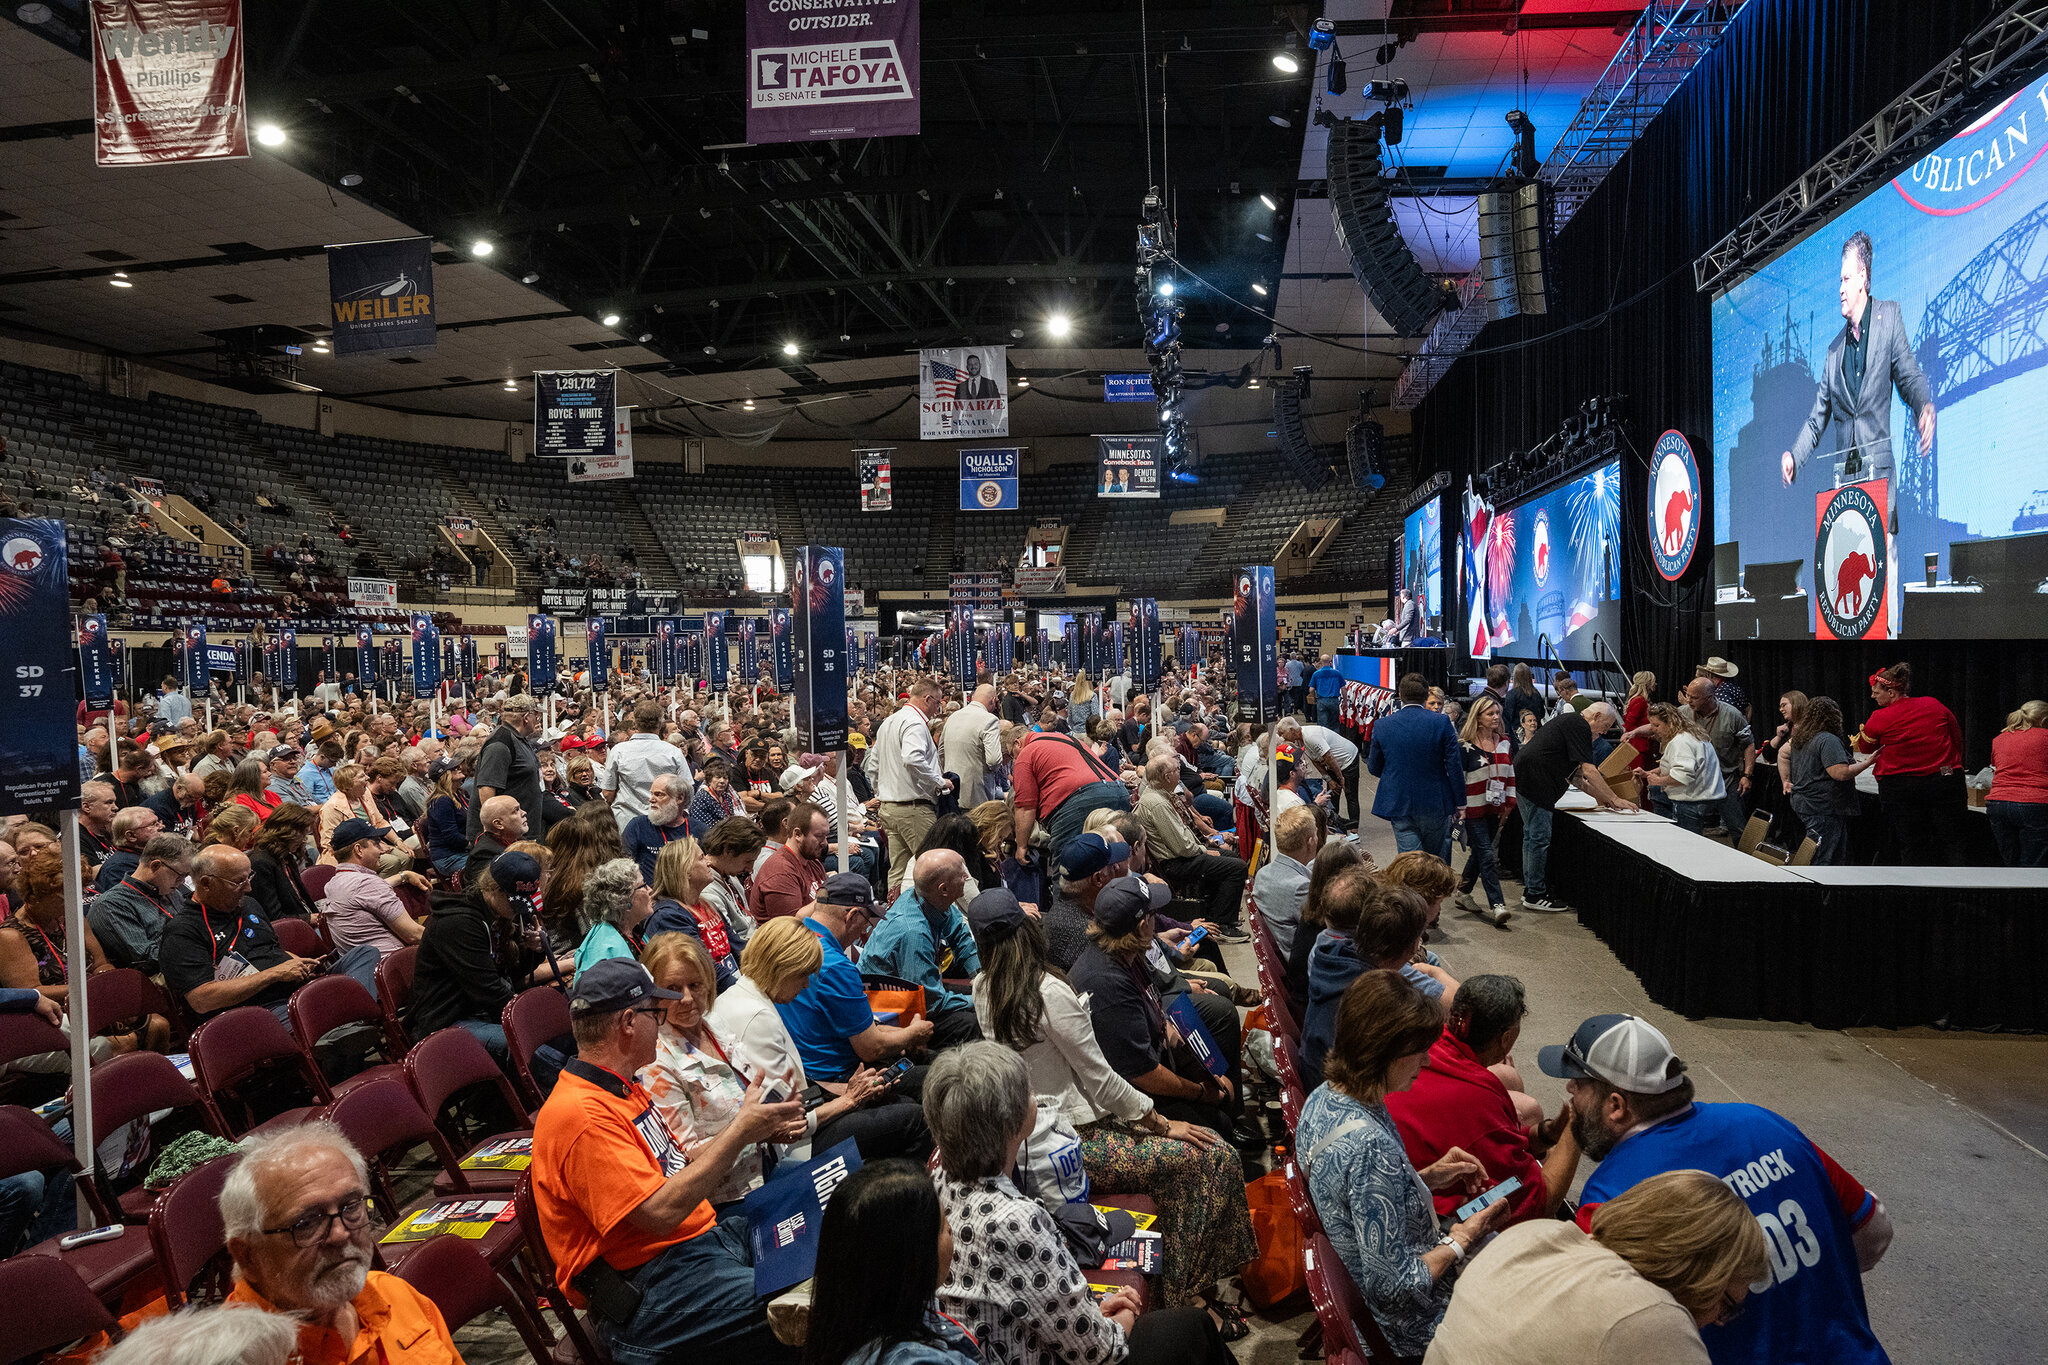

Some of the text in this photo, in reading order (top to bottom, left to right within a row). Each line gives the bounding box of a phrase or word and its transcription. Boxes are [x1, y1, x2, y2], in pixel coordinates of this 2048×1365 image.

[789, 12, 873, 31] OUTSIDER.
[101, 20, 235, 60] Wendy
[791, 48, 857, 65] MICHELE
[137, 69, 200, 88] Phillips
[790, 62, 900, 88] TAFOYA
[758, 90, 816, 102] U.S. SENATE
[104, 108, 175, 124] Secretary
[200, 104, 238, 117] State
[334, 294, 430, 322] WEILER
[556, 378, 596, 390] 1,291,712
[922, 400, 1005, 413] SCHWARZE
[548, 408, 602, 419] ROYCE WHITE
[966, 454, 1013, 468] QUALLS
[1109, 450, 1151, 459] MINNESOTA'S
[1651, 436, 1689, 480] MINNESOTA
[1134, 469, 1156, 477] DEMUTH
[140, 487, 163, 496] JUDE
[1823, 490, 1877, 532] MINNESOTA
[1292, 543, 1305, 557] 24
[1652, 523, 1696, 572] REPUBLICAN PARTY
[350, 582, 387, 594] LISA DEMUTH
[593, 589, 607, 599] PRO
[611, 589, 626, 600] LIFE
[542, 595, 586, 605] ROYCE WHITE
[593, 602, 627, 610] ROYCE WHITE
[1819, 591, 1879, 637] REPUBLICAN PARTY
[823, 650, 834, 658] SD
[16, 666, 44, 678] SD
[92, 649, 101, 686] MEEKER
[824, 663, 834, 671] 35
[19, 684, 43, 697] 37
[5, 783, 37, 791] Republican
[38, 782, 52, 790] Party
[24, 797, 42, 805] Duluth,
[790, 1212, 805, 1231] LISA
[777, 1218, 794, 1247] DEMUTH
[1142, 1239, 1154, 1272] Leadership
